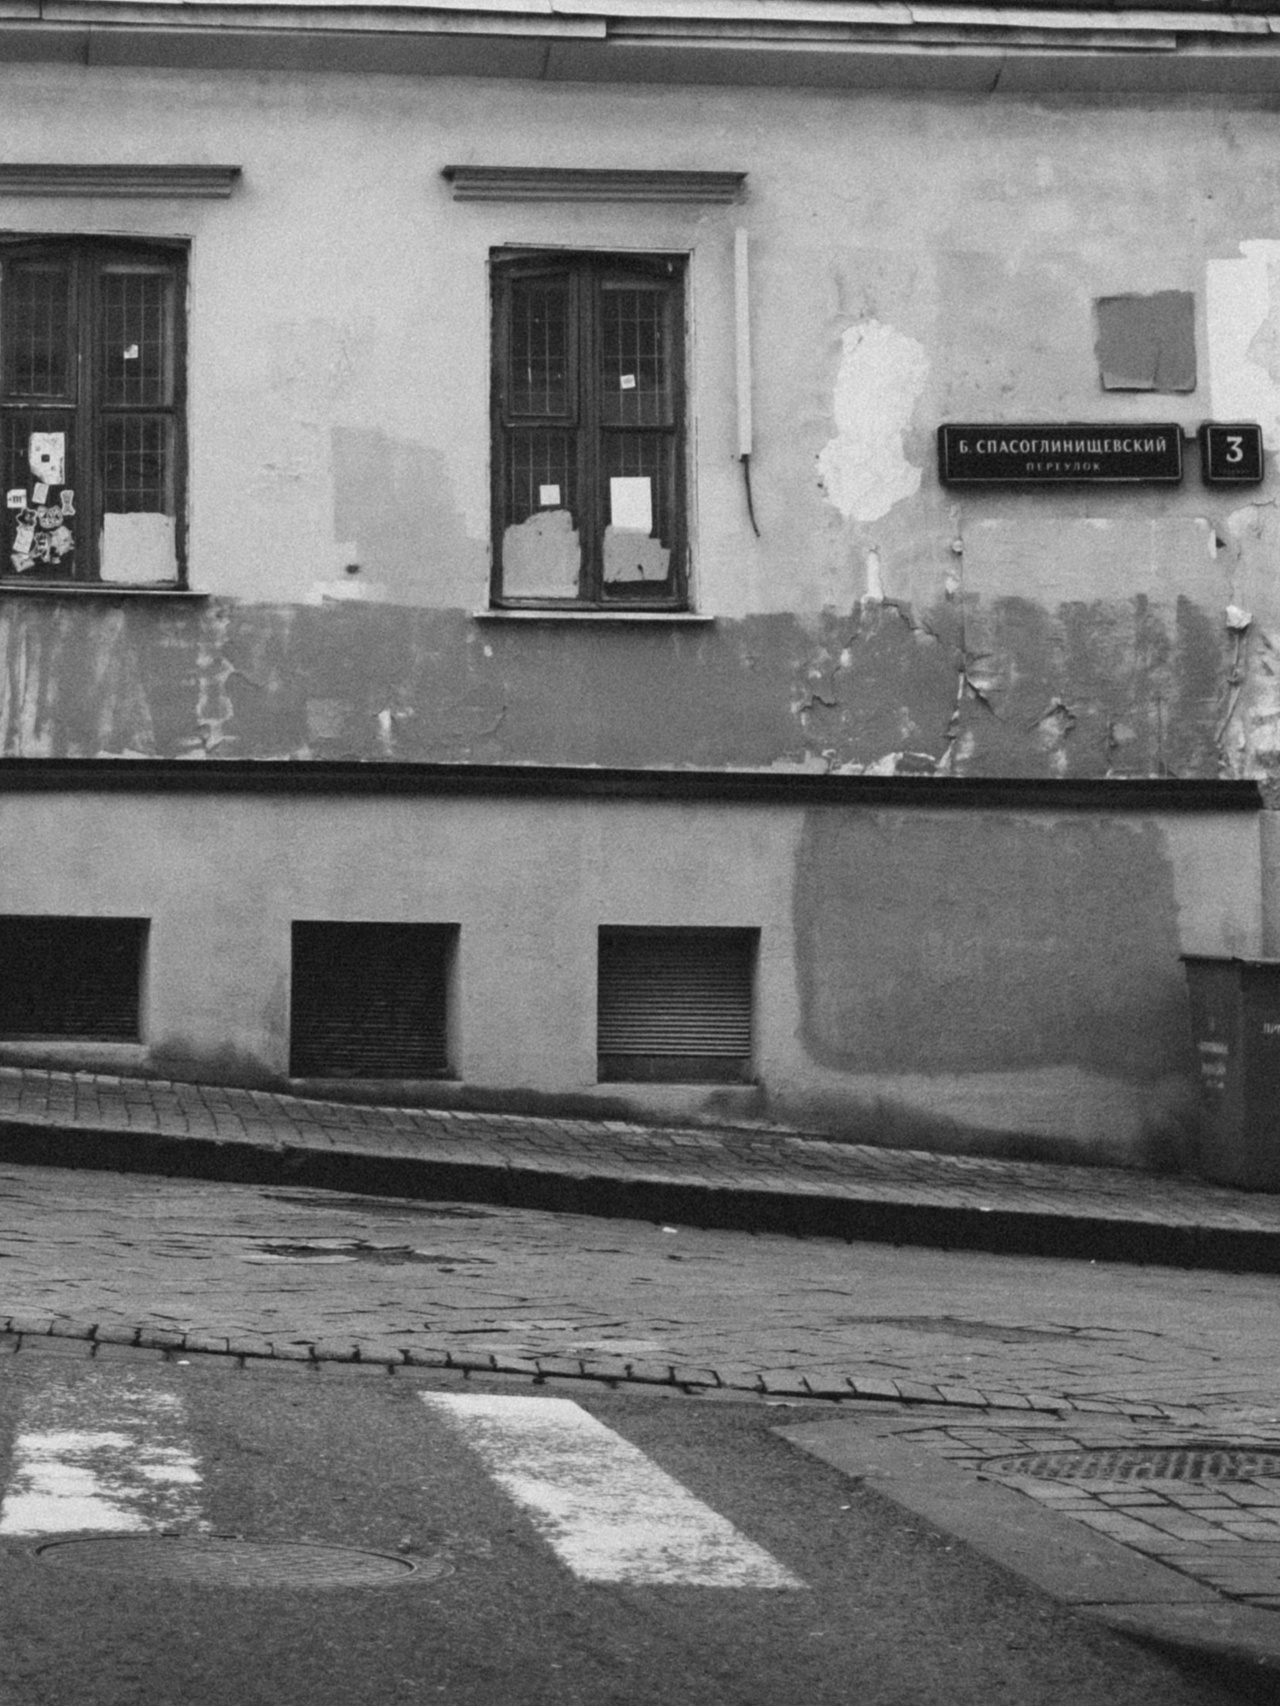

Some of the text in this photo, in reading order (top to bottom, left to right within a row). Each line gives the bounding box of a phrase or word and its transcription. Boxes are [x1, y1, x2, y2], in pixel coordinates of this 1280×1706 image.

[959, 436, 1167, 454] Б. СПАСОГЛИНИЩЕВСКИЙ
[1225, 435, 1244, 462] 3
[1025, 461, 1101, 472] ПЕРЕУЛОК
